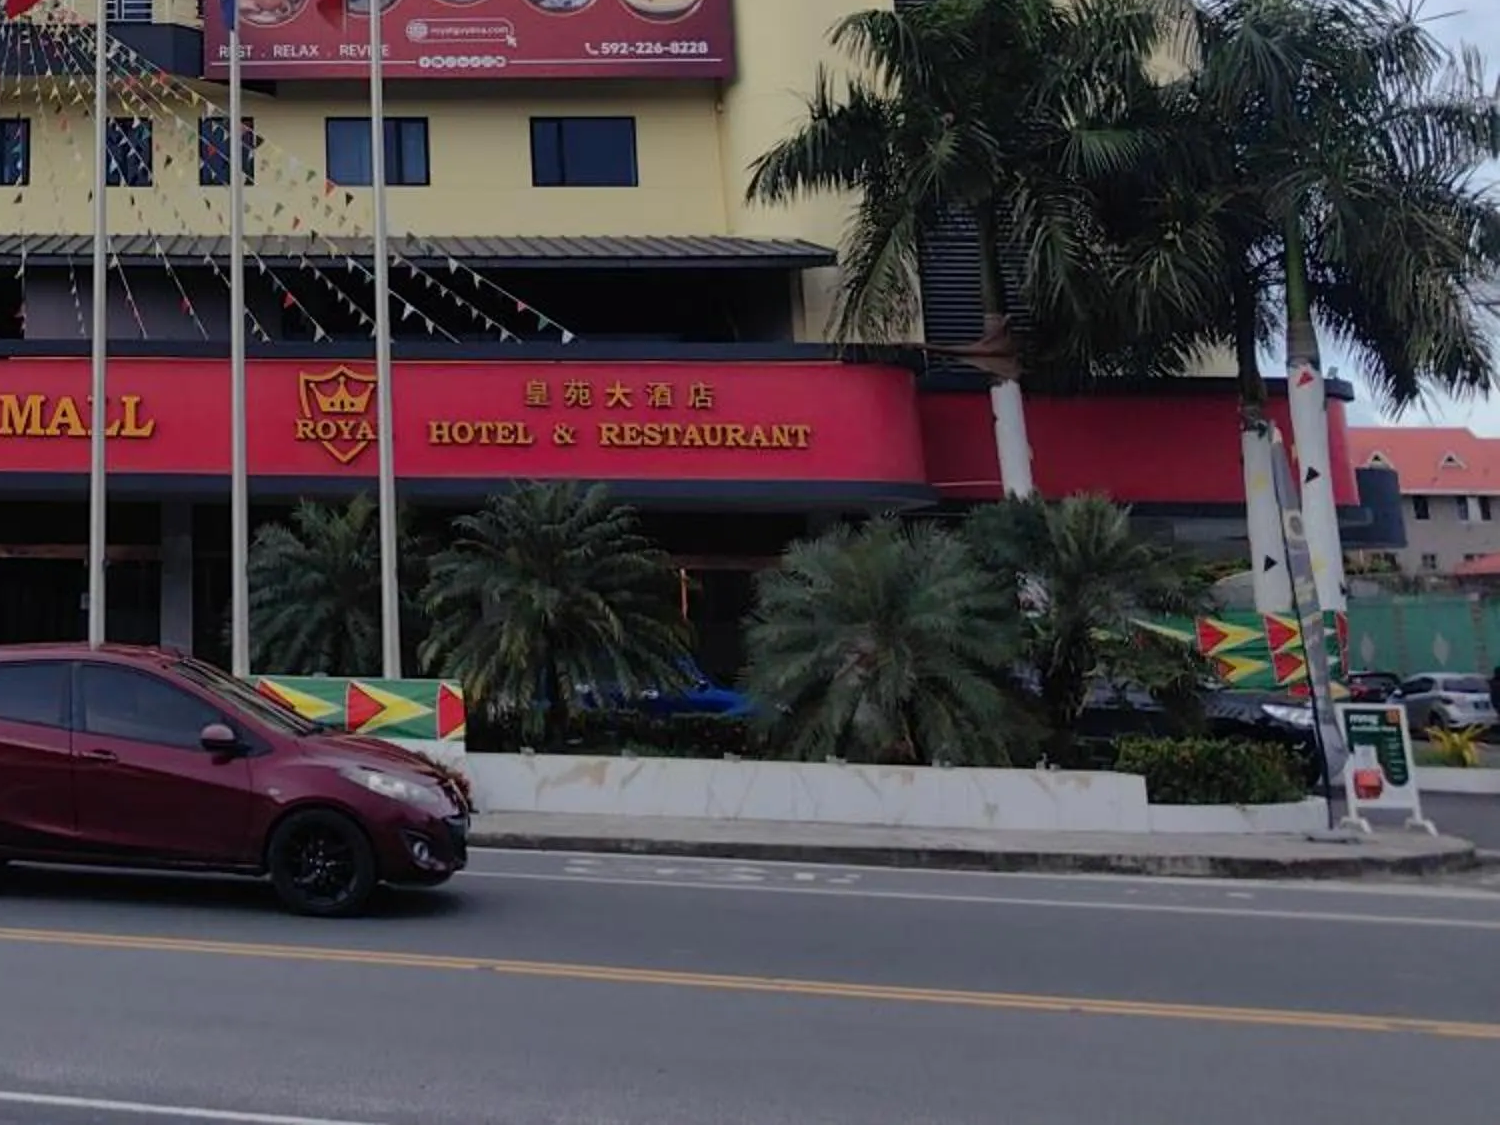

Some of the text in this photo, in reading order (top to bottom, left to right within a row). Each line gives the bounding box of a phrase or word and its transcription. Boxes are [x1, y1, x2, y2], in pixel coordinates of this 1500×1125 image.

[273, 44, 319, 58] RELAX
[339, 43, 390, 58] REVIE
[525, 380, 714, 409] 皇苑大酒店
[296, 419, 377, 440] ROYA
[429, 420, 810, 449] HOTEL & RESTAURANT
